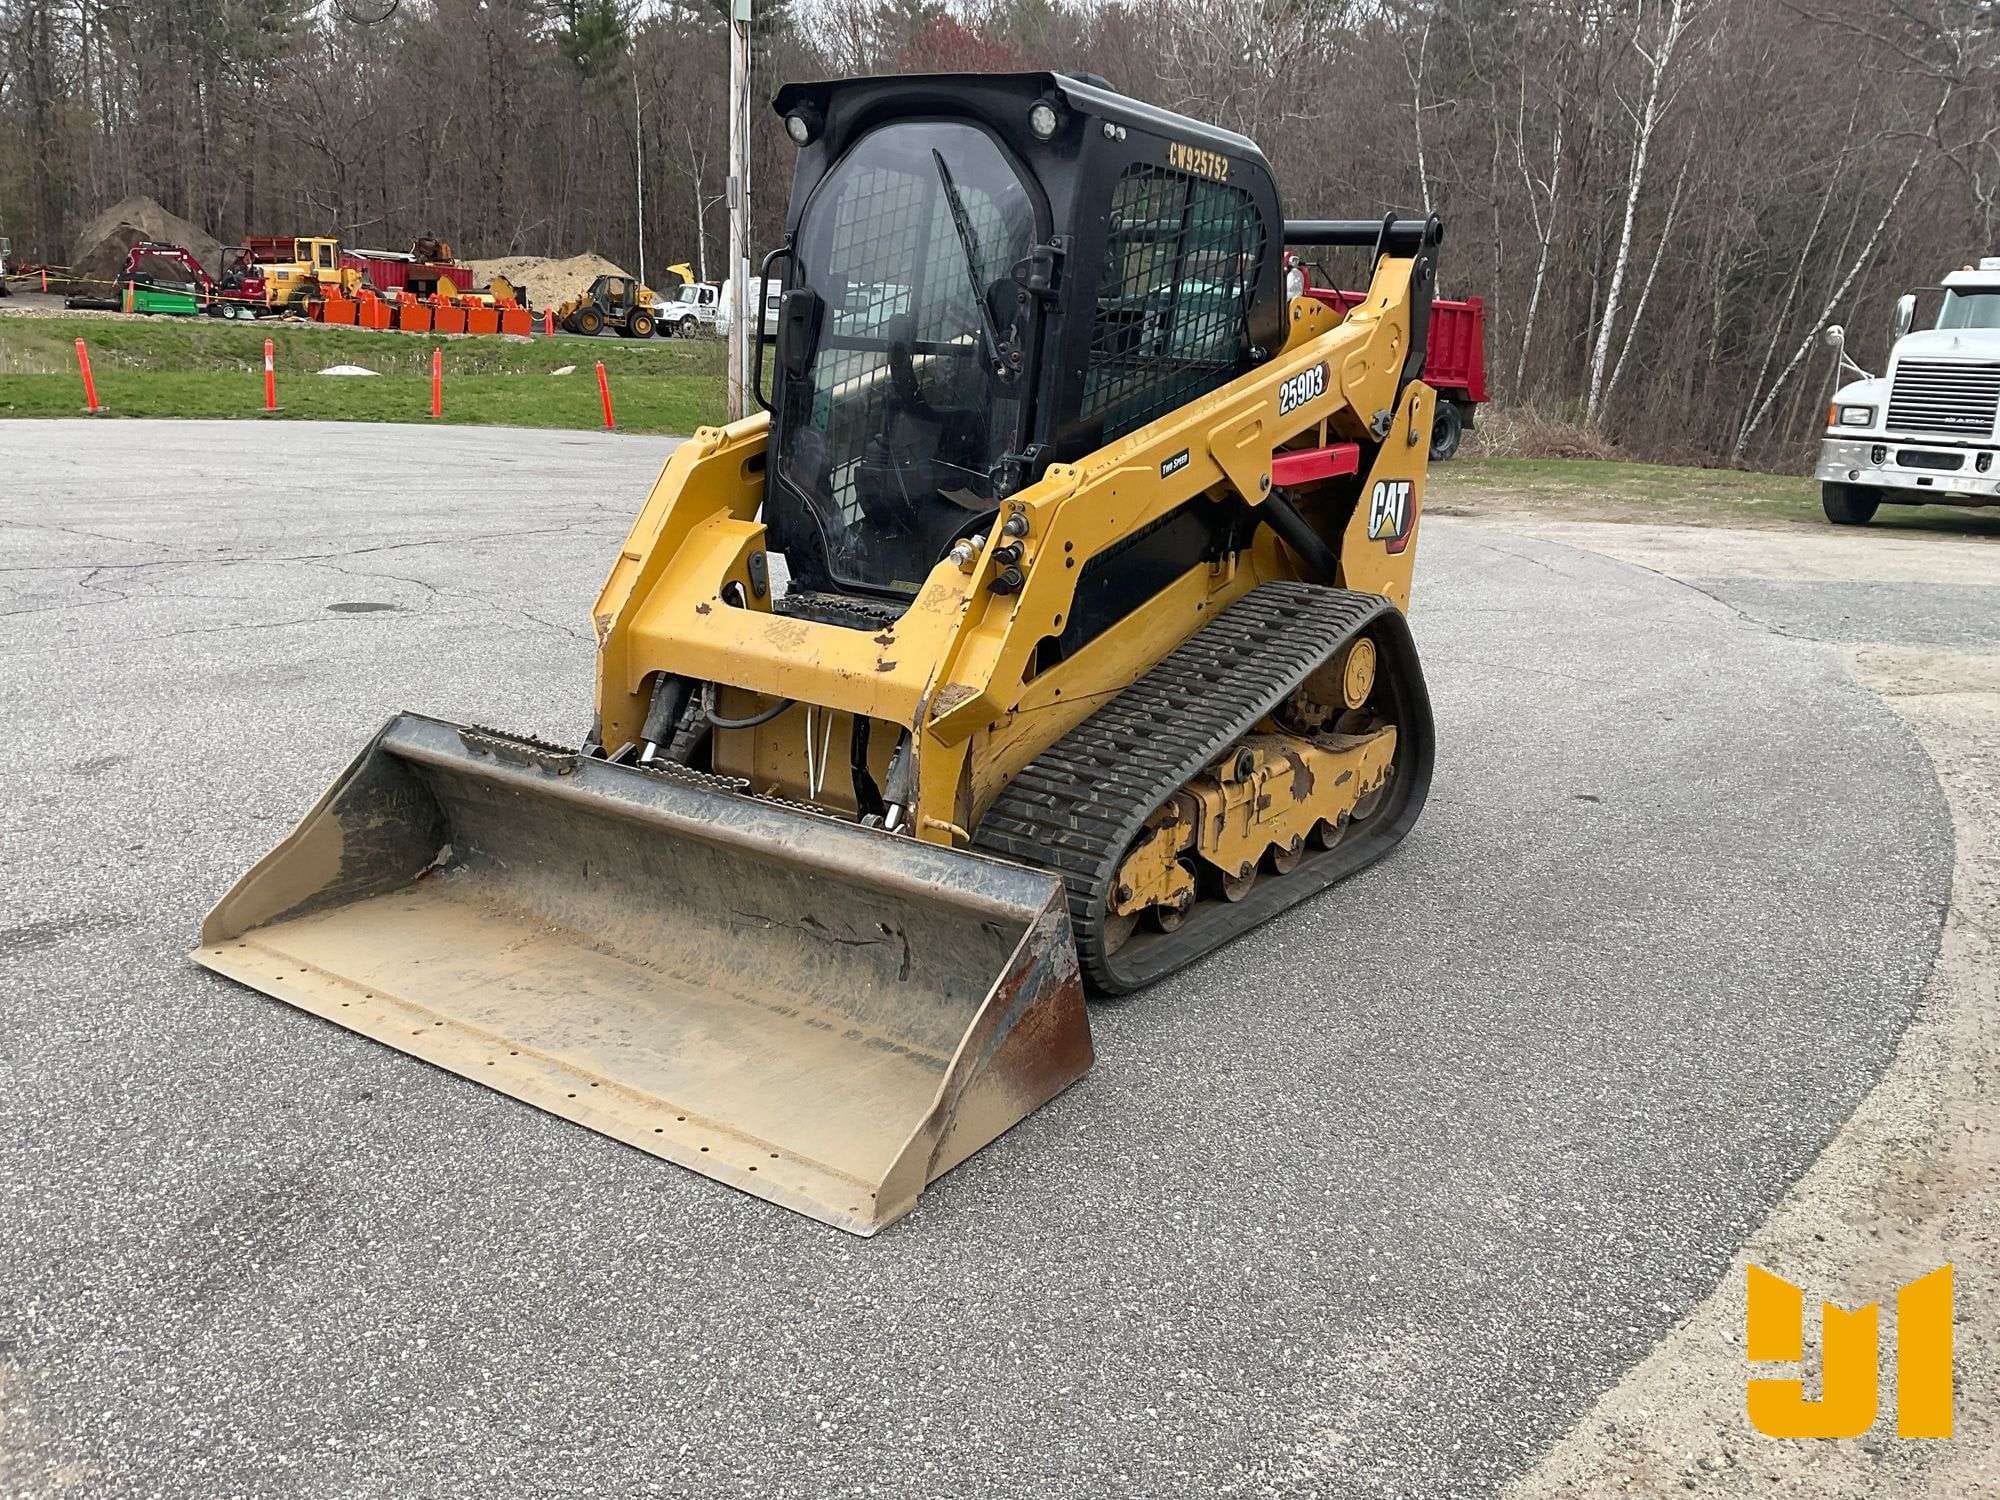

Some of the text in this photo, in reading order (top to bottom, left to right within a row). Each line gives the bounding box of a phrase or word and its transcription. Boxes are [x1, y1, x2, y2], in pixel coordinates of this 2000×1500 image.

[1169, 142, 1228, 181] CW925752
[1280, 364, 1323, 415] 259D3
[1369, 482, 1410, 538] CAT
